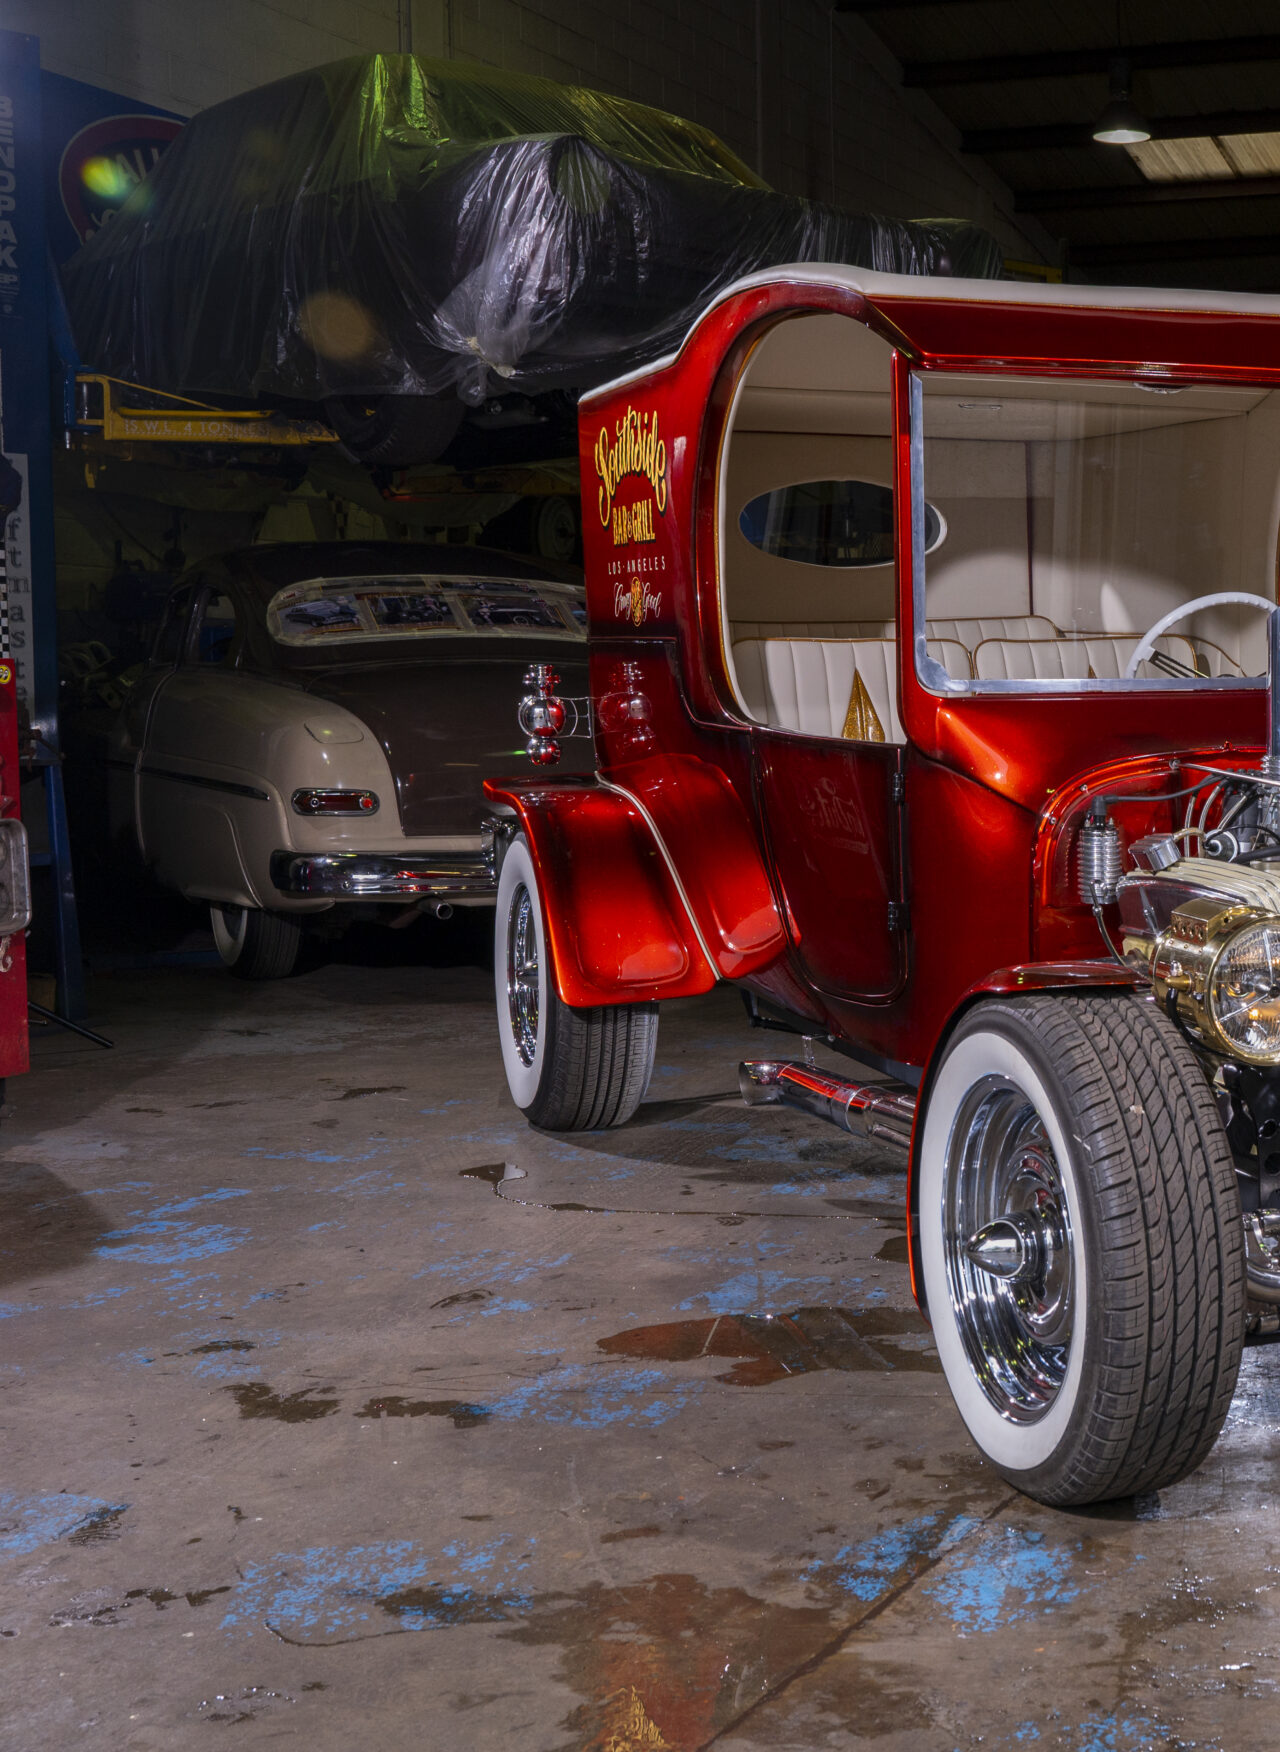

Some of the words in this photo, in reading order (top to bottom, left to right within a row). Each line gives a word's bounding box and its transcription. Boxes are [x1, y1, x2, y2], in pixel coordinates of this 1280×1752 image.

[184, 421, 193, 433] 4
[595, 405, 667, 527] Southside
[626, 555, 666, 573] ANGELES
